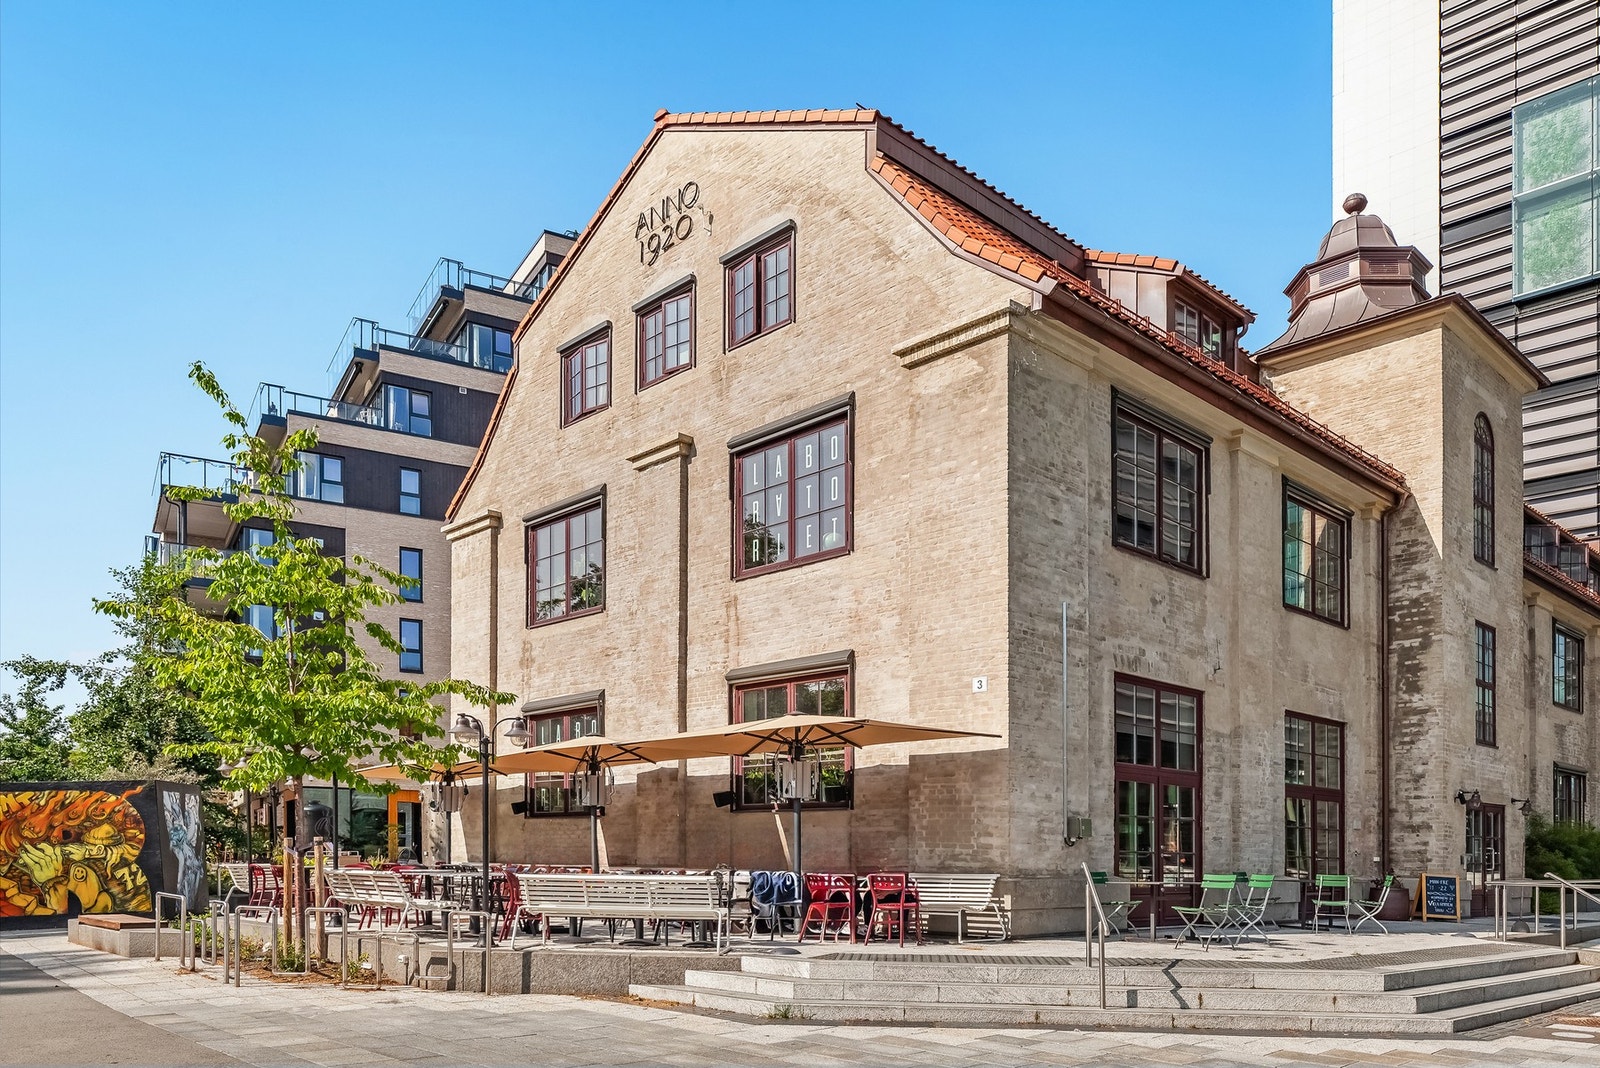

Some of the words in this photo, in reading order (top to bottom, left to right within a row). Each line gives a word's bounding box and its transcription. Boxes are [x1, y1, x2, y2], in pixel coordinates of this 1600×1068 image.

[635, 181, 700, 239] ANNO
[640, 214, 694, 267] 1920
[977, 679, 983, 690] 3
